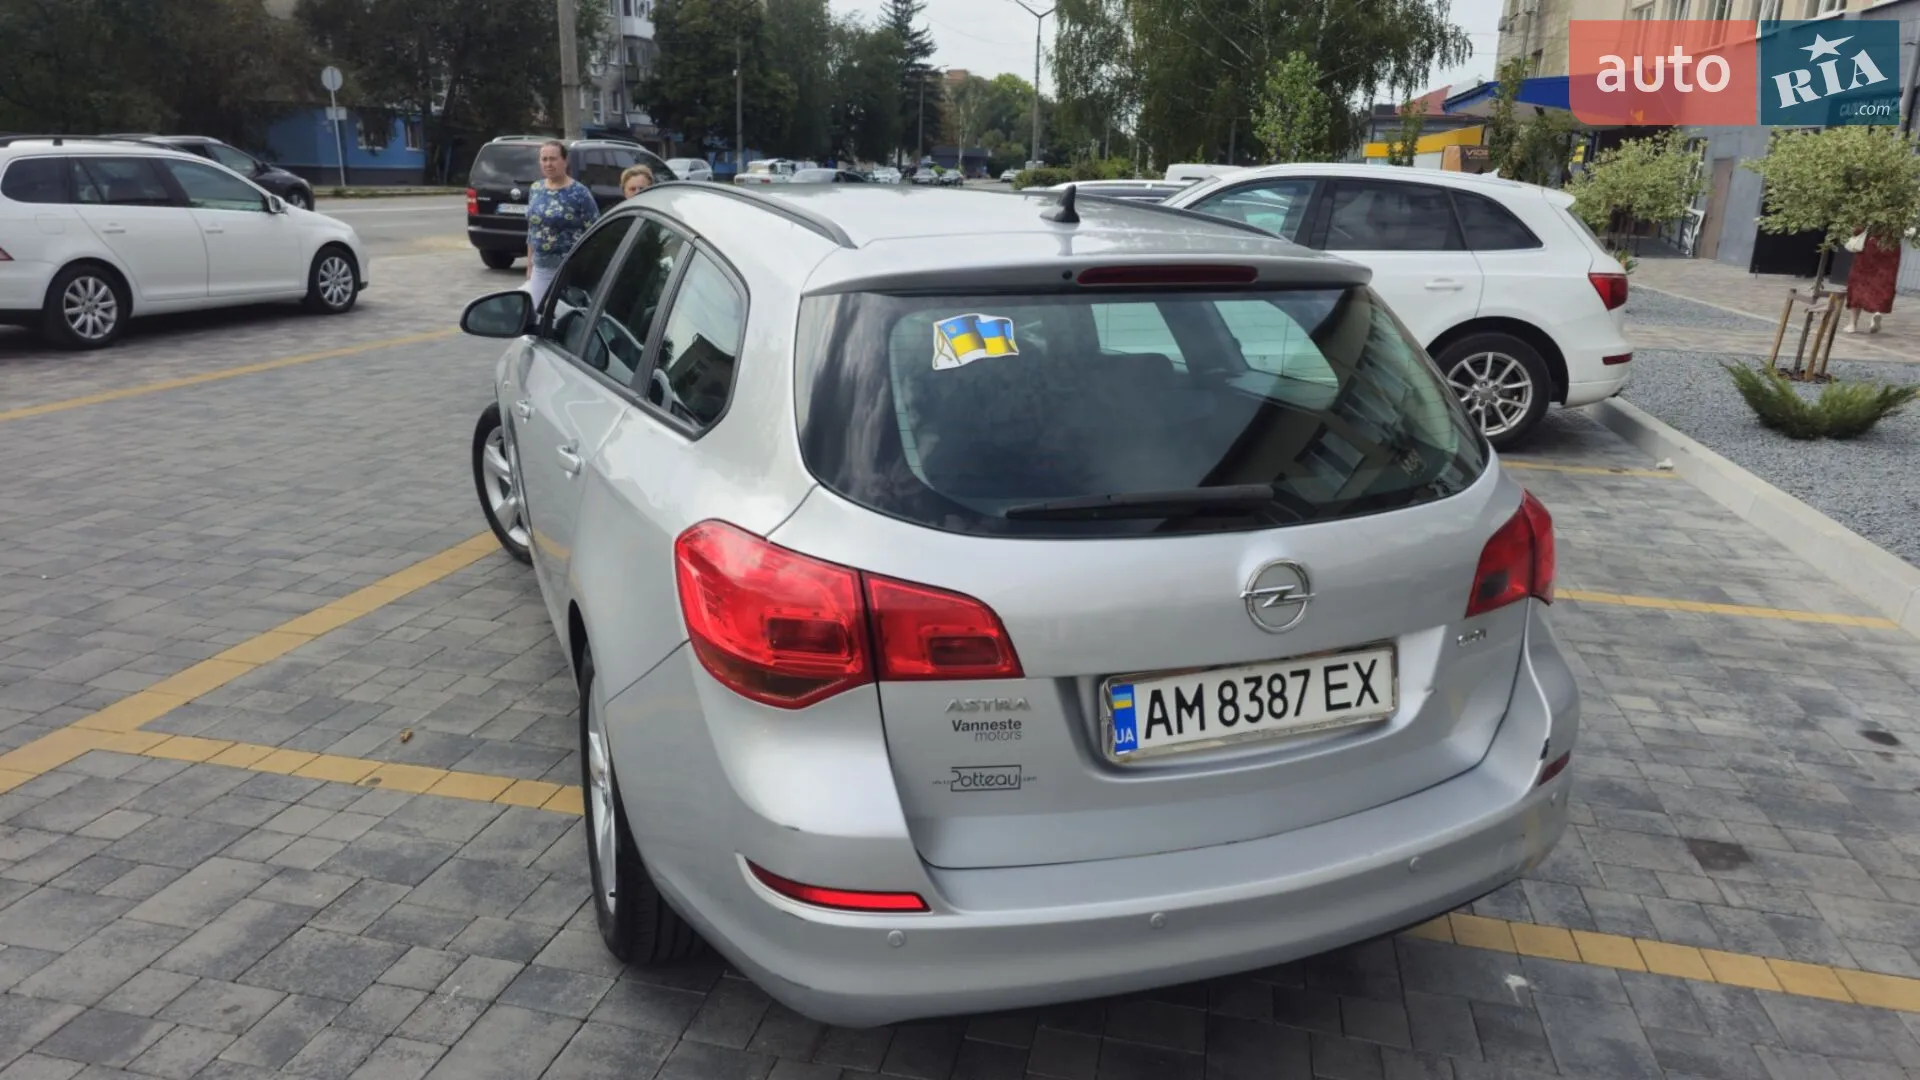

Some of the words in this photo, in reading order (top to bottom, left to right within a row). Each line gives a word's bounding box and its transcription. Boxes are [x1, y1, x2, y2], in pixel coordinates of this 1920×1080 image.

[945, 698, 1032, 712] ASTRA
[1145, 683, 1205, 739] AM
[1217, 673, 1311, 727] 8387
[1323, 658, 1380, 712] EX
[952, 719, 1022, 732] Vanneste
[975, 730, 1022, 742] motors
[1115, 728, 1136, 744] UA
